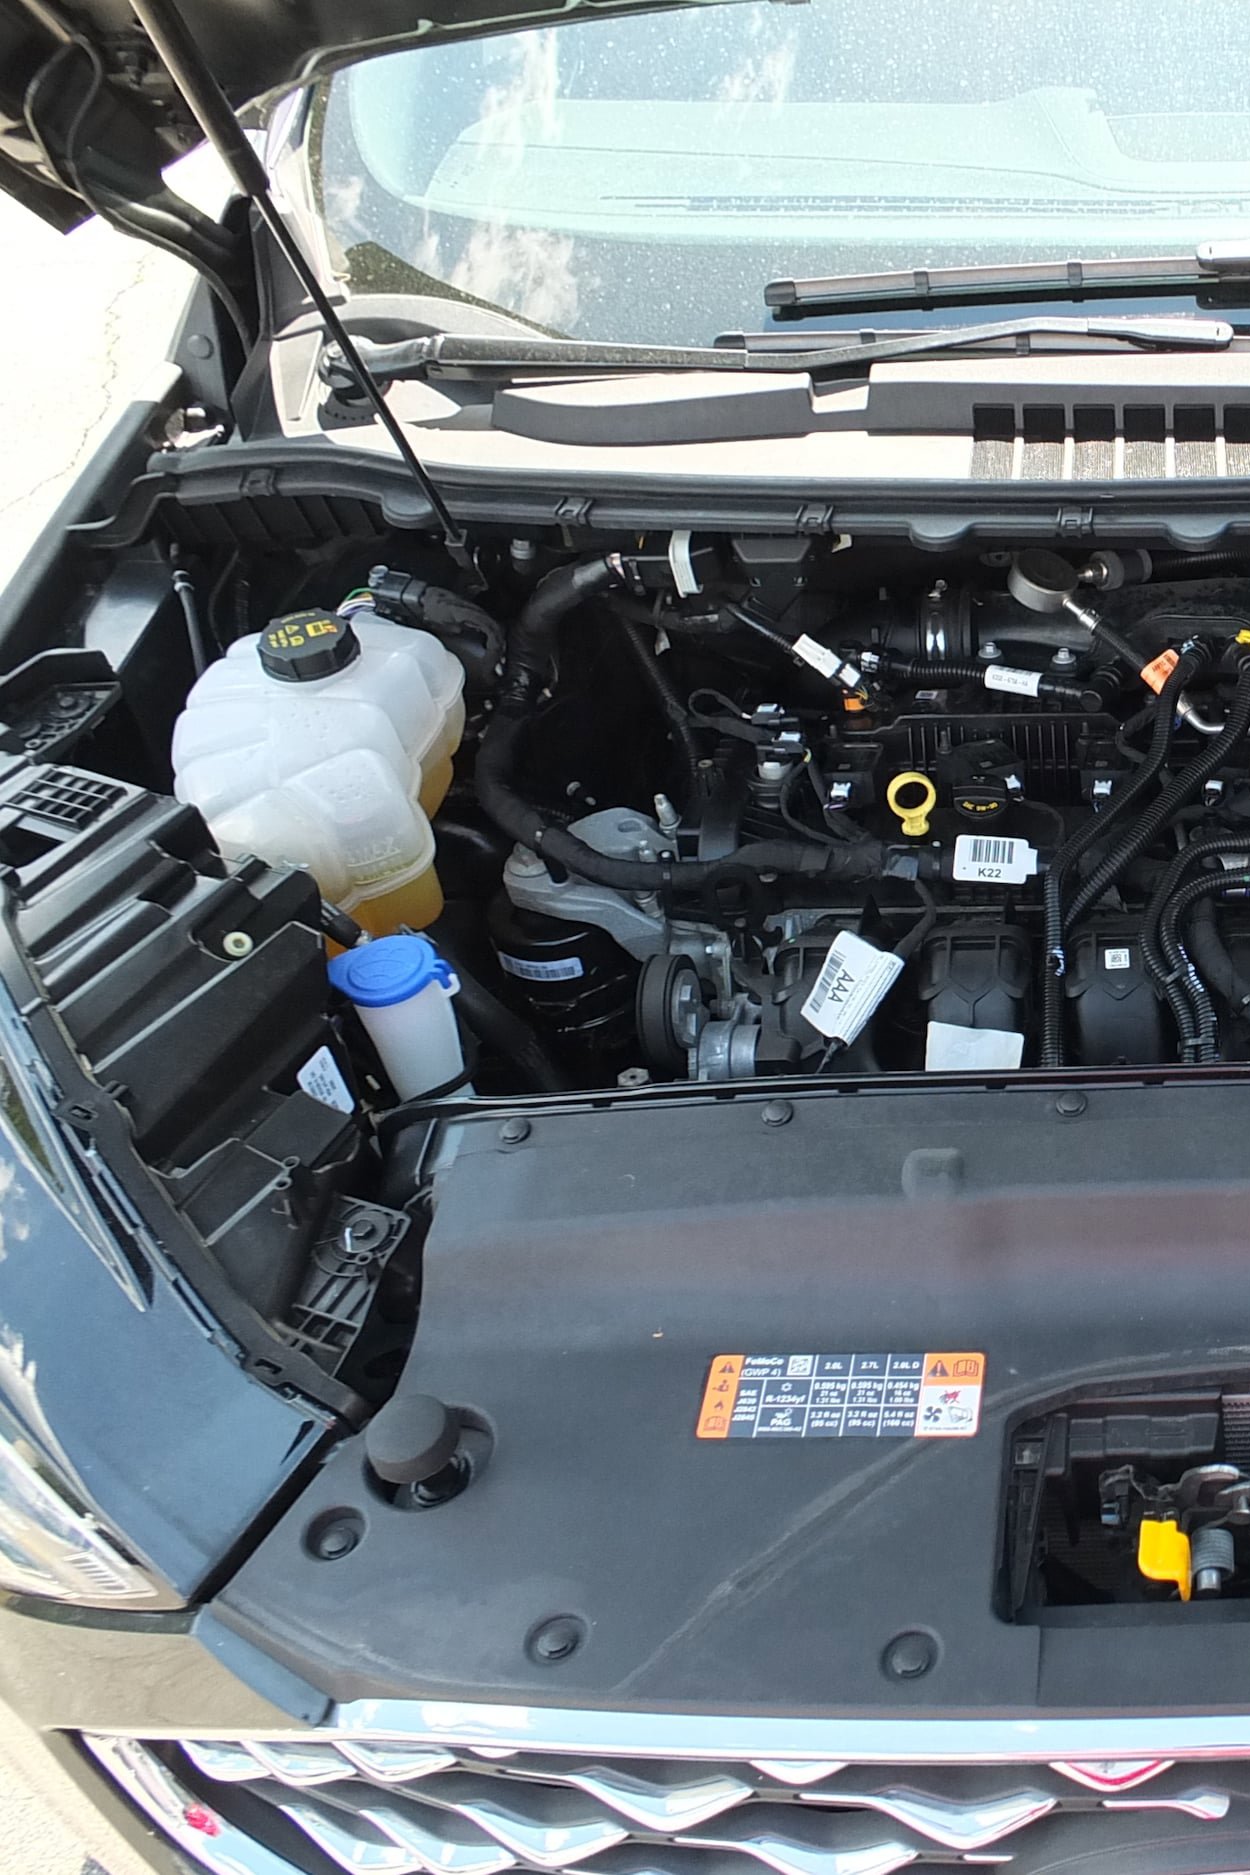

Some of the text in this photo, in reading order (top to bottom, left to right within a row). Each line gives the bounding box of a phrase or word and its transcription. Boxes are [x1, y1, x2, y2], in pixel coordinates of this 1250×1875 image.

[977, 867, 1002, 879] K22
[827, 969, 856, 1003] AAA
[860, 1361, 879, 1370] 2.7L
[741, 1368, 782, 1377] (GWP 4)
[836, 1382, 847, 1391] kg
[873, 1382, 883, 1391] kg
[887, 1382, 919, 1391] 0.454 kg
[765, 1394, 806, 1404] R-1234yf
[770, 1418, 792, 1426] PAG
